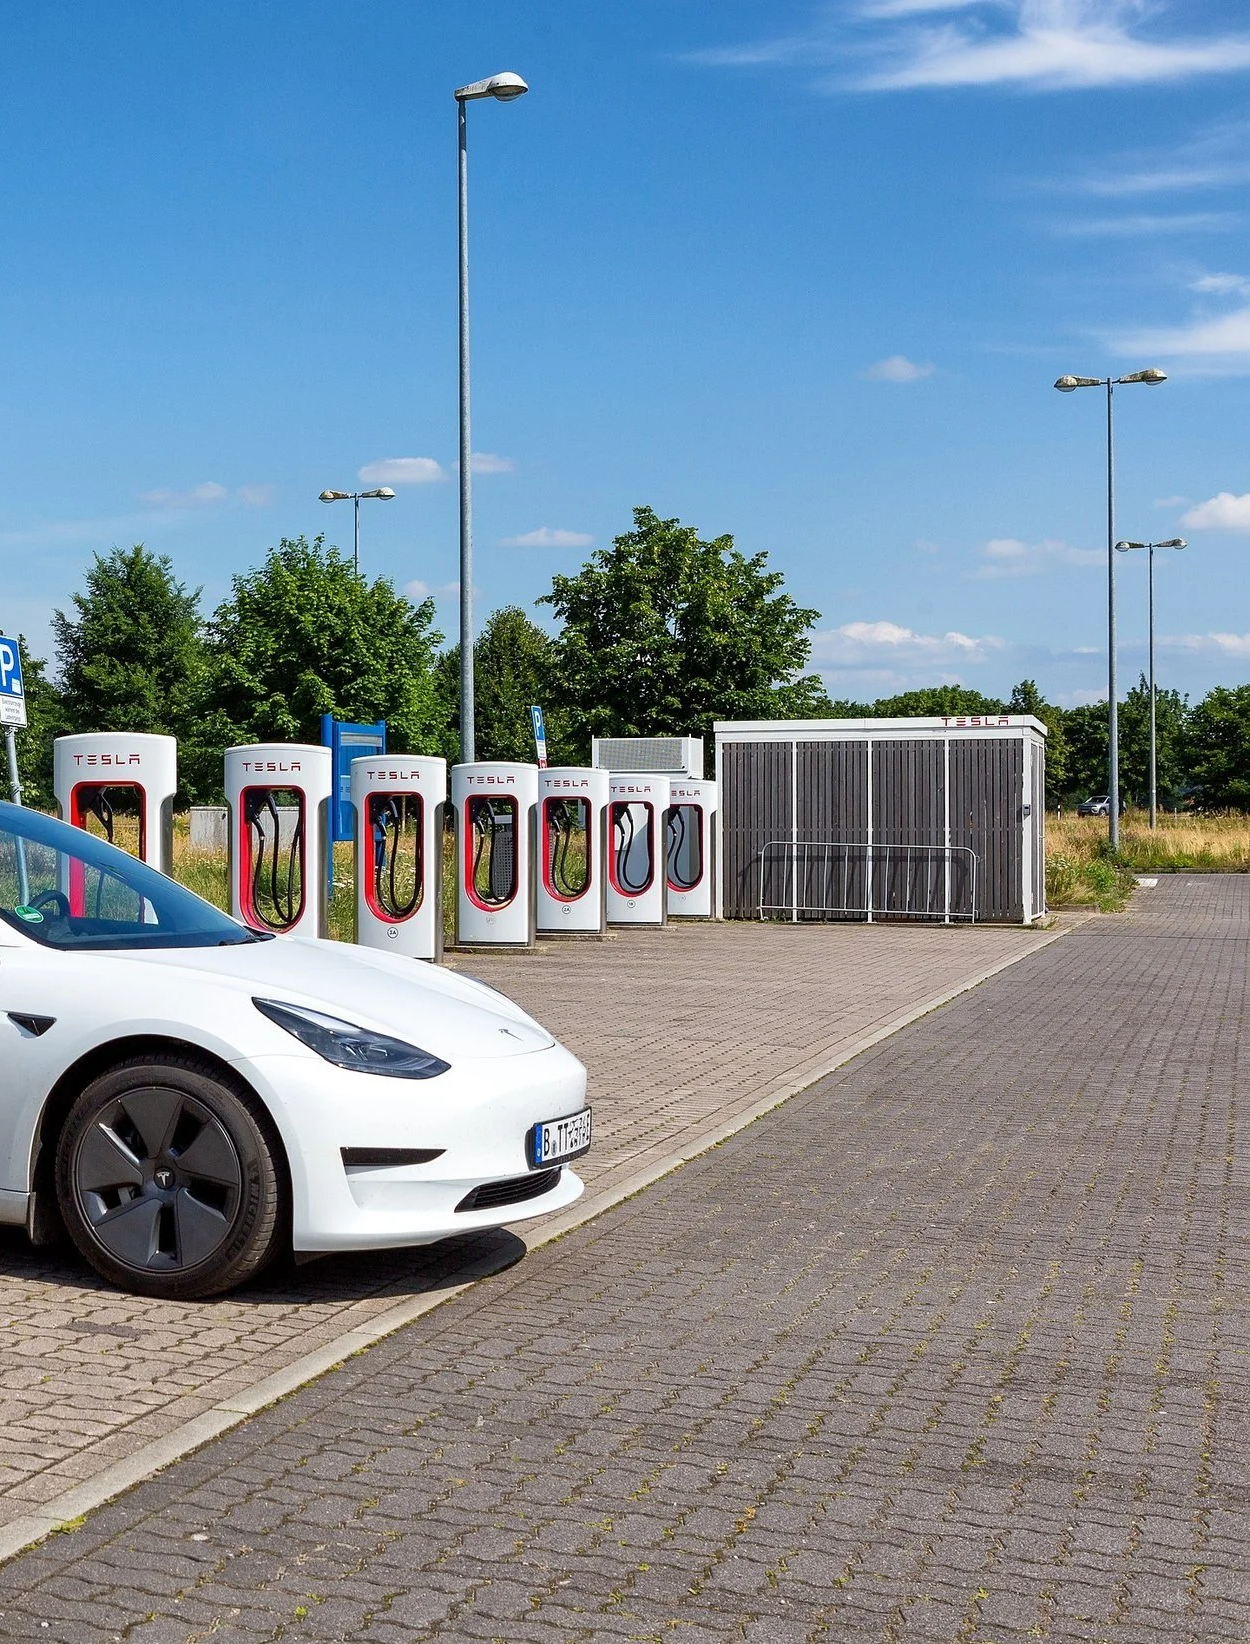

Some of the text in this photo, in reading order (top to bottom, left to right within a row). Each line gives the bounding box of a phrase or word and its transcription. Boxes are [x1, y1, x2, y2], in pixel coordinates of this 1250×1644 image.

[941, 716, 1009, 727] TESLA
[72, 753, 141, 766] TESLA
[241, 761, 301, 772] TESLA
[367, 771, 419, 780] TESLA
[467, 776, 514, 785] TESLA
[544, 780, 588, 788] TESLA
[610, 785, 651, 793] TESLA
[671, 789, 701, 797] ESLA
[544, 1128, 550, 1156] B
